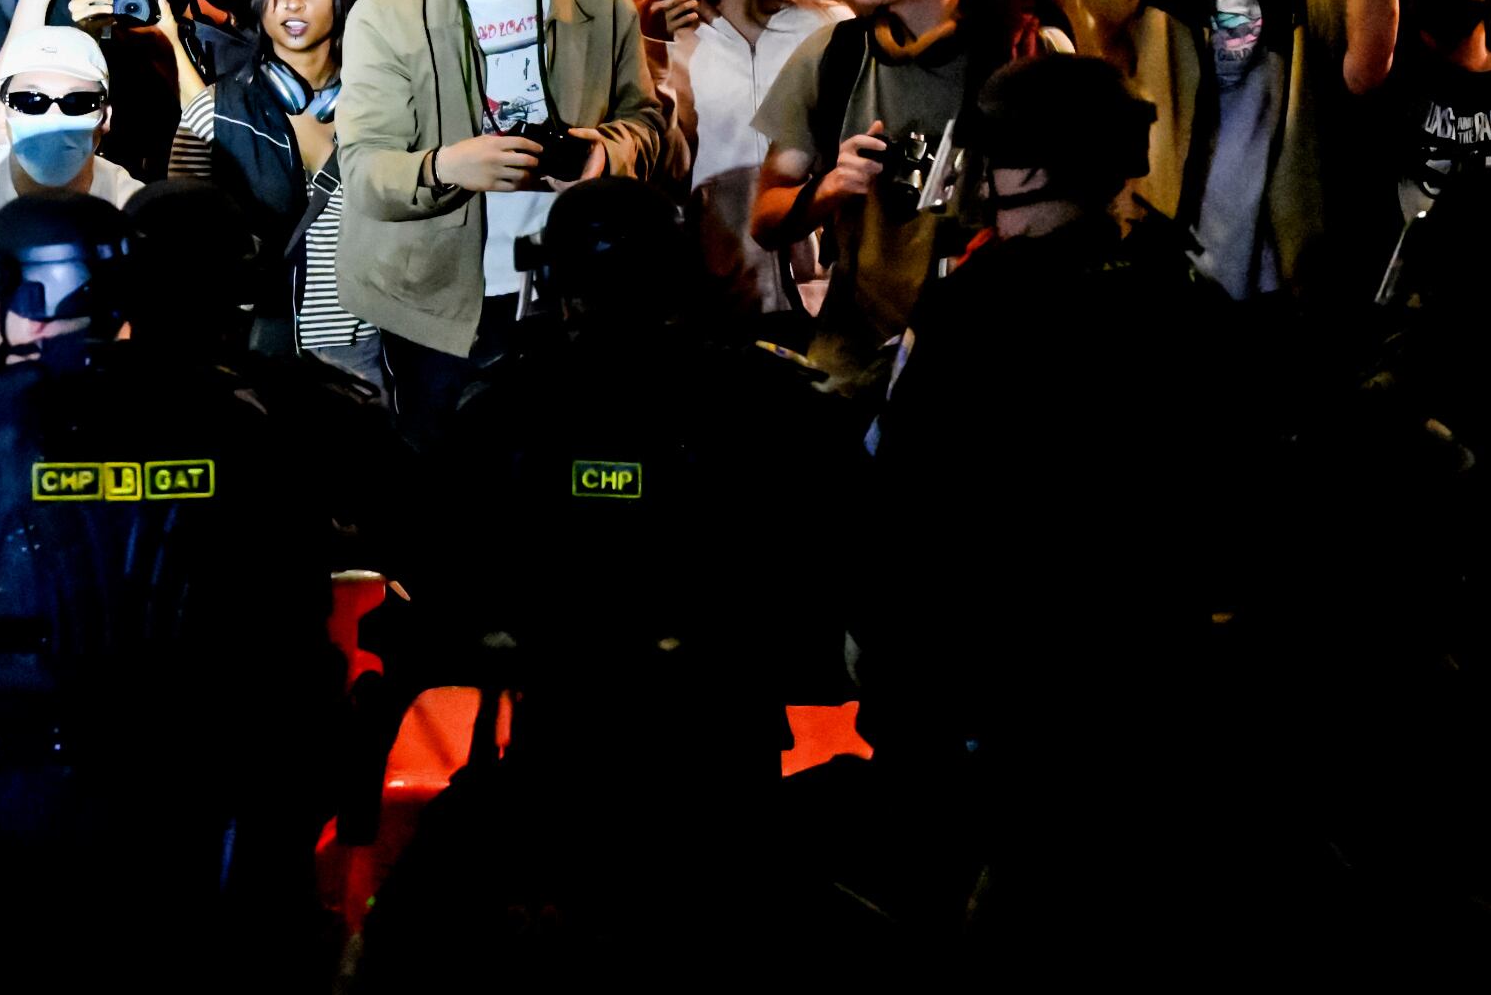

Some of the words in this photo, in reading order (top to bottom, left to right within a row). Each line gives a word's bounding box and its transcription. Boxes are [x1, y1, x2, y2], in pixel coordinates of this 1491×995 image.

[41, 470, 95, 492] CHP
[154, 468, 205, 490] GAT
[581, 468, 633, 490] CHP
